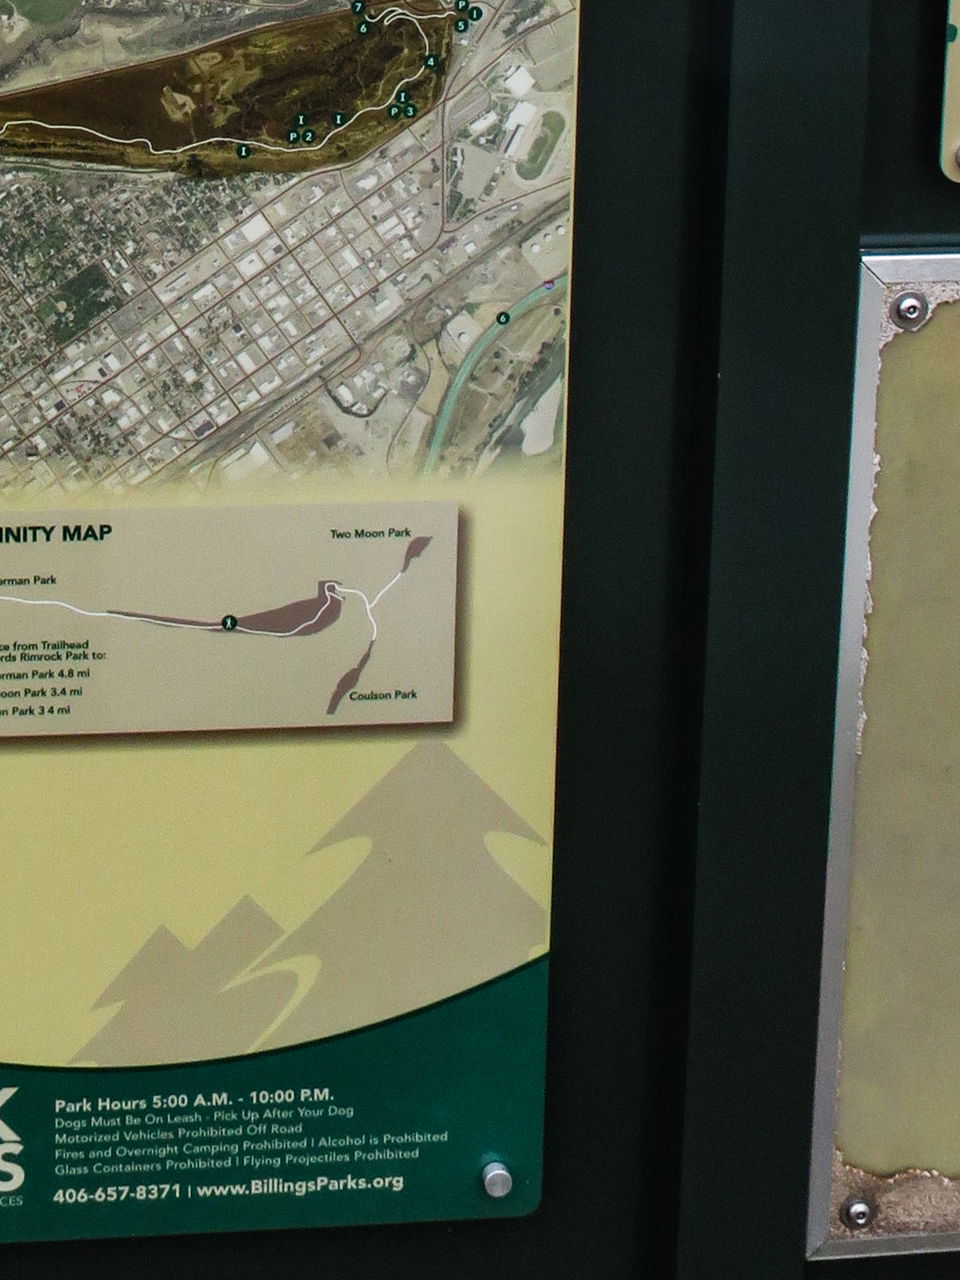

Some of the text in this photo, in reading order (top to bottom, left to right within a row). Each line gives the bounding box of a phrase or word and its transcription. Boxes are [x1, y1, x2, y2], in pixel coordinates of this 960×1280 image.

[63, 525, 112, 542] MAP
[331, 528, 411, 539] Two Moon Park
[34, 576, 56, 584] Park
[13, 642, 38, 650] from
[42, 640, 88, 649] Trailhead
[20, 652, 62, 661] Rimrock
[66, 652, 88, 660] Park
[92, 652, 106, 660] to:
[32, 670, 54, 679] Park
[58, 669, 73, 678] 4.8
[77, 669, 90, 677] mi
[24, 688, 46, 697] Park
[51, 688, 66, 696] 3.4
[70, 688, 82, 696] mi
[350, 690, 417, 700] Coulson Park
[12, 706, 35, 715] Park
[58, 706, 70, 714] mi
[55, 1088, 334, 1113] Park Hours 5:00 A.M. 10:00 P.M.
[55, 1106, 354, 1131] Dogs Must Be On Leash Pick Up After Your Dog
[55, 1123, 302, 1144] Motorized Vehicles Prohibited Off Road
[55, 1132, 448, 1160] Fires and Overnight Camping Prohibited Alcohol is Prohibited
[55, 1148, 419, 1175] Glass Containers Prohibited Flying Projectiles Prohibited
[53, 1175, 403, 1204] 406-657-8371 www.BillingsParks.org
